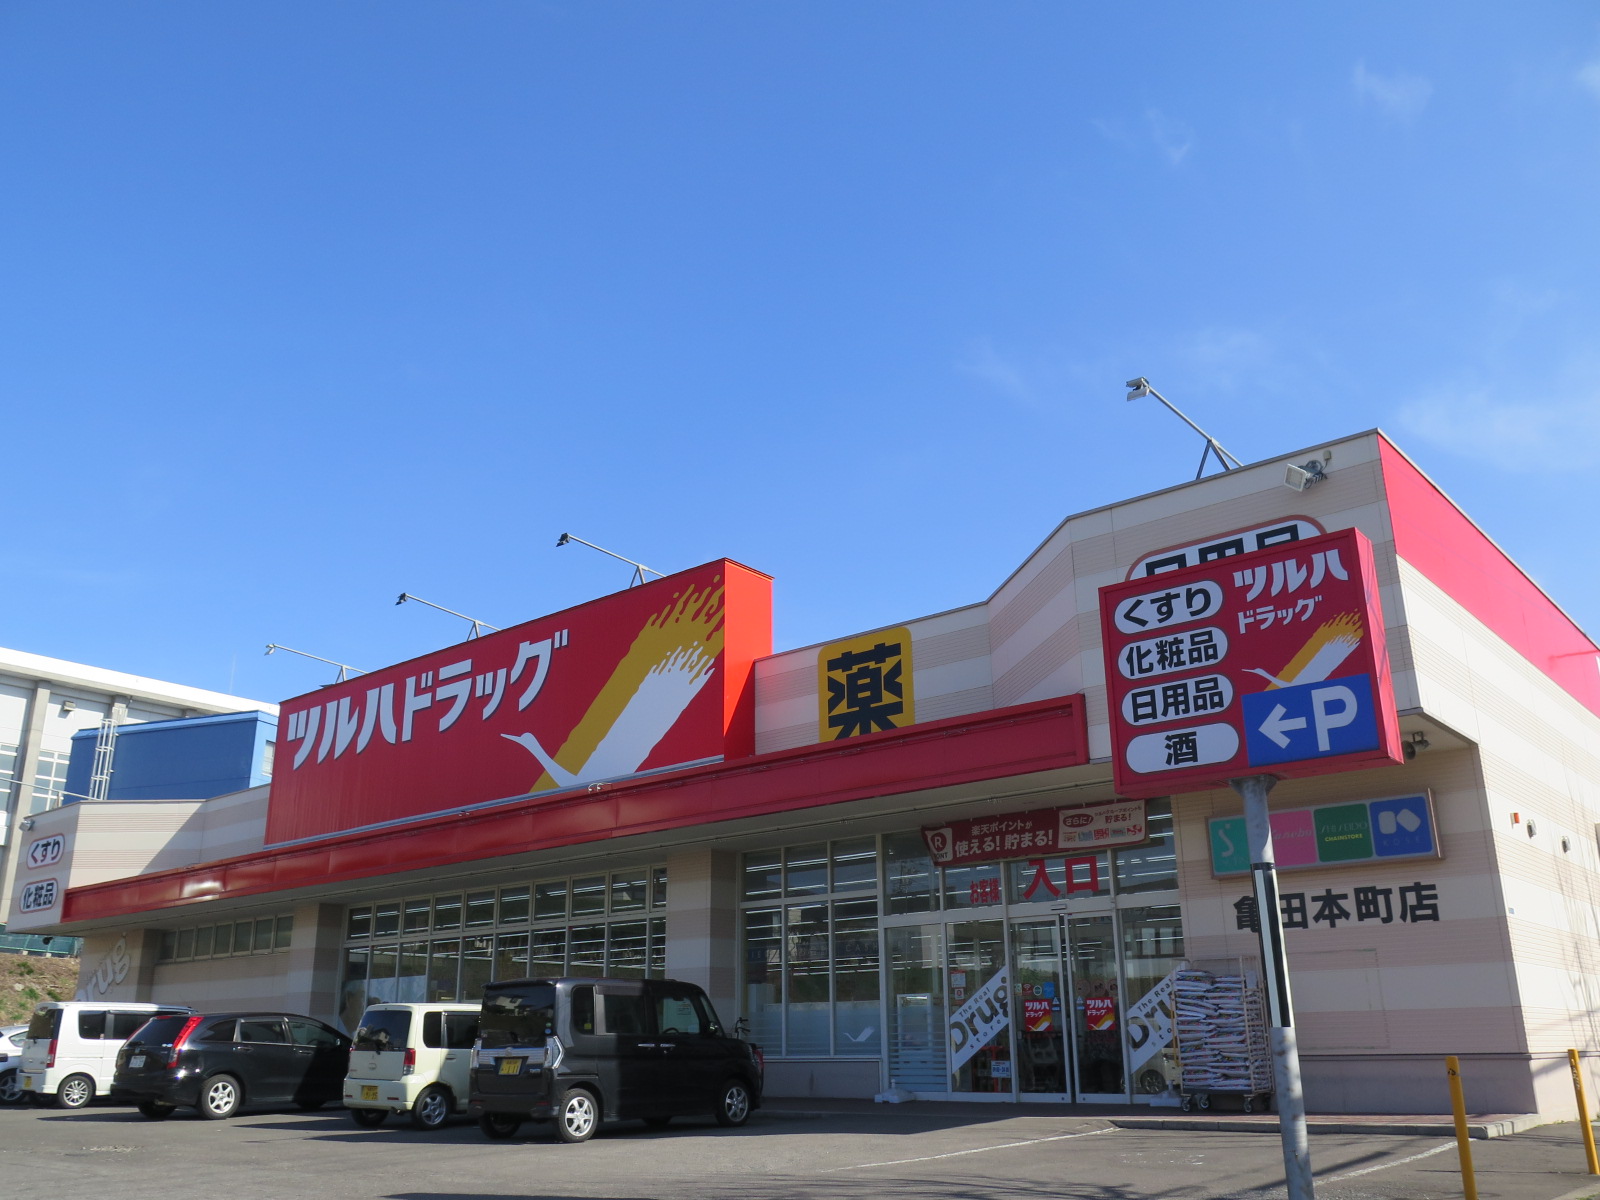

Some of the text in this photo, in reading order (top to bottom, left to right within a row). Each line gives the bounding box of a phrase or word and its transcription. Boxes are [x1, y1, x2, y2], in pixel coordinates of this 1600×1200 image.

[1233, 549, 1348, 602] ツルハ
[1123, 587, 1211, 627] くすり
[1238, 596, 1322, 634] ドラッグ
[1126, 630, 1218, 677] 化粧品
[287, 628, 568, 770] ツルハドラッグ
[827, 642, 904, 741] 薬
[1132, 677, 1224, 723] 日用品
[1311, 685, 1357, 752] P
[1164, 731, 1199, 766] 酒
[971, 820, 1033, 837] 楽天ポイントが
[1324, 833, 1363, 842] CHAINSTORE
[30, 838, 61, 864] くすり
[23, 882, 54, 910] 化粧品
[1023, 856, 1099, 899] 入口
[75, 937, 131, 1003] rug
[1025, 1001, 1050, 1010] ツルハ
[1086, 999, 1112, 1008] ツルハ
